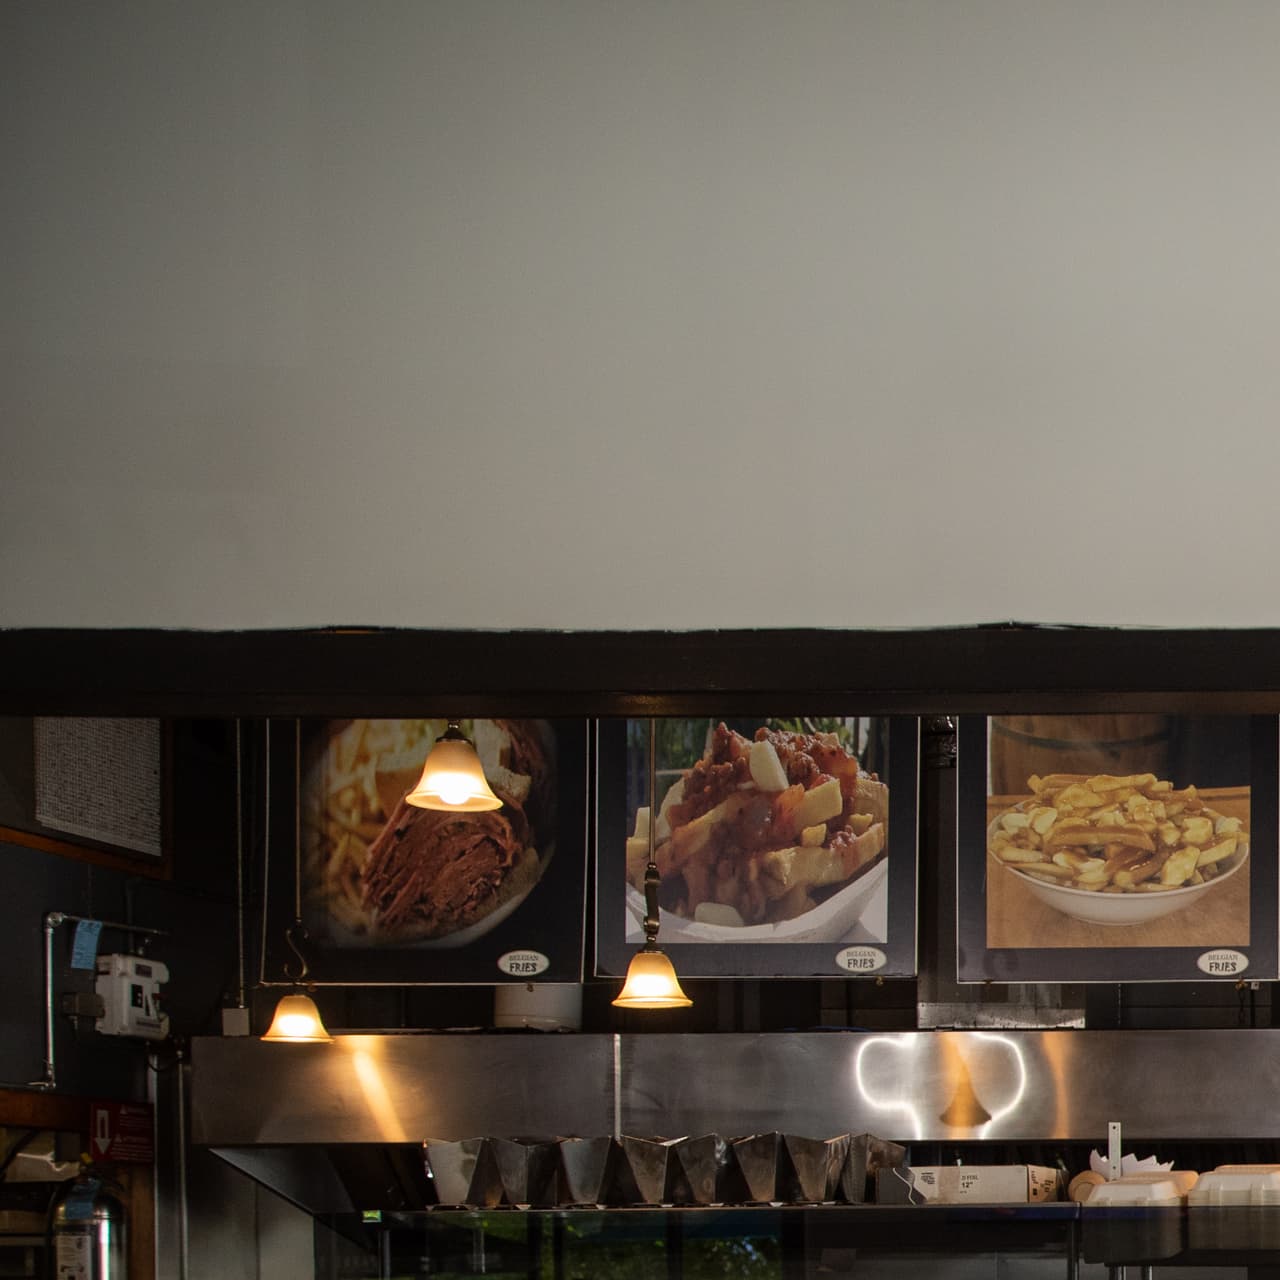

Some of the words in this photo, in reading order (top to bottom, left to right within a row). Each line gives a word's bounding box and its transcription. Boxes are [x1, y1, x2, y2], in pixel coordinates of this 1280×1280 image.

[846, 950, 877, 958] BELGIAN
[1208, 954, 1238, 962] BELGIAN
[509, 961, 537, 973] FRIES
[847, 958, 875, 969] FRIES
[1209, 961, 1237, 973] FRIES
